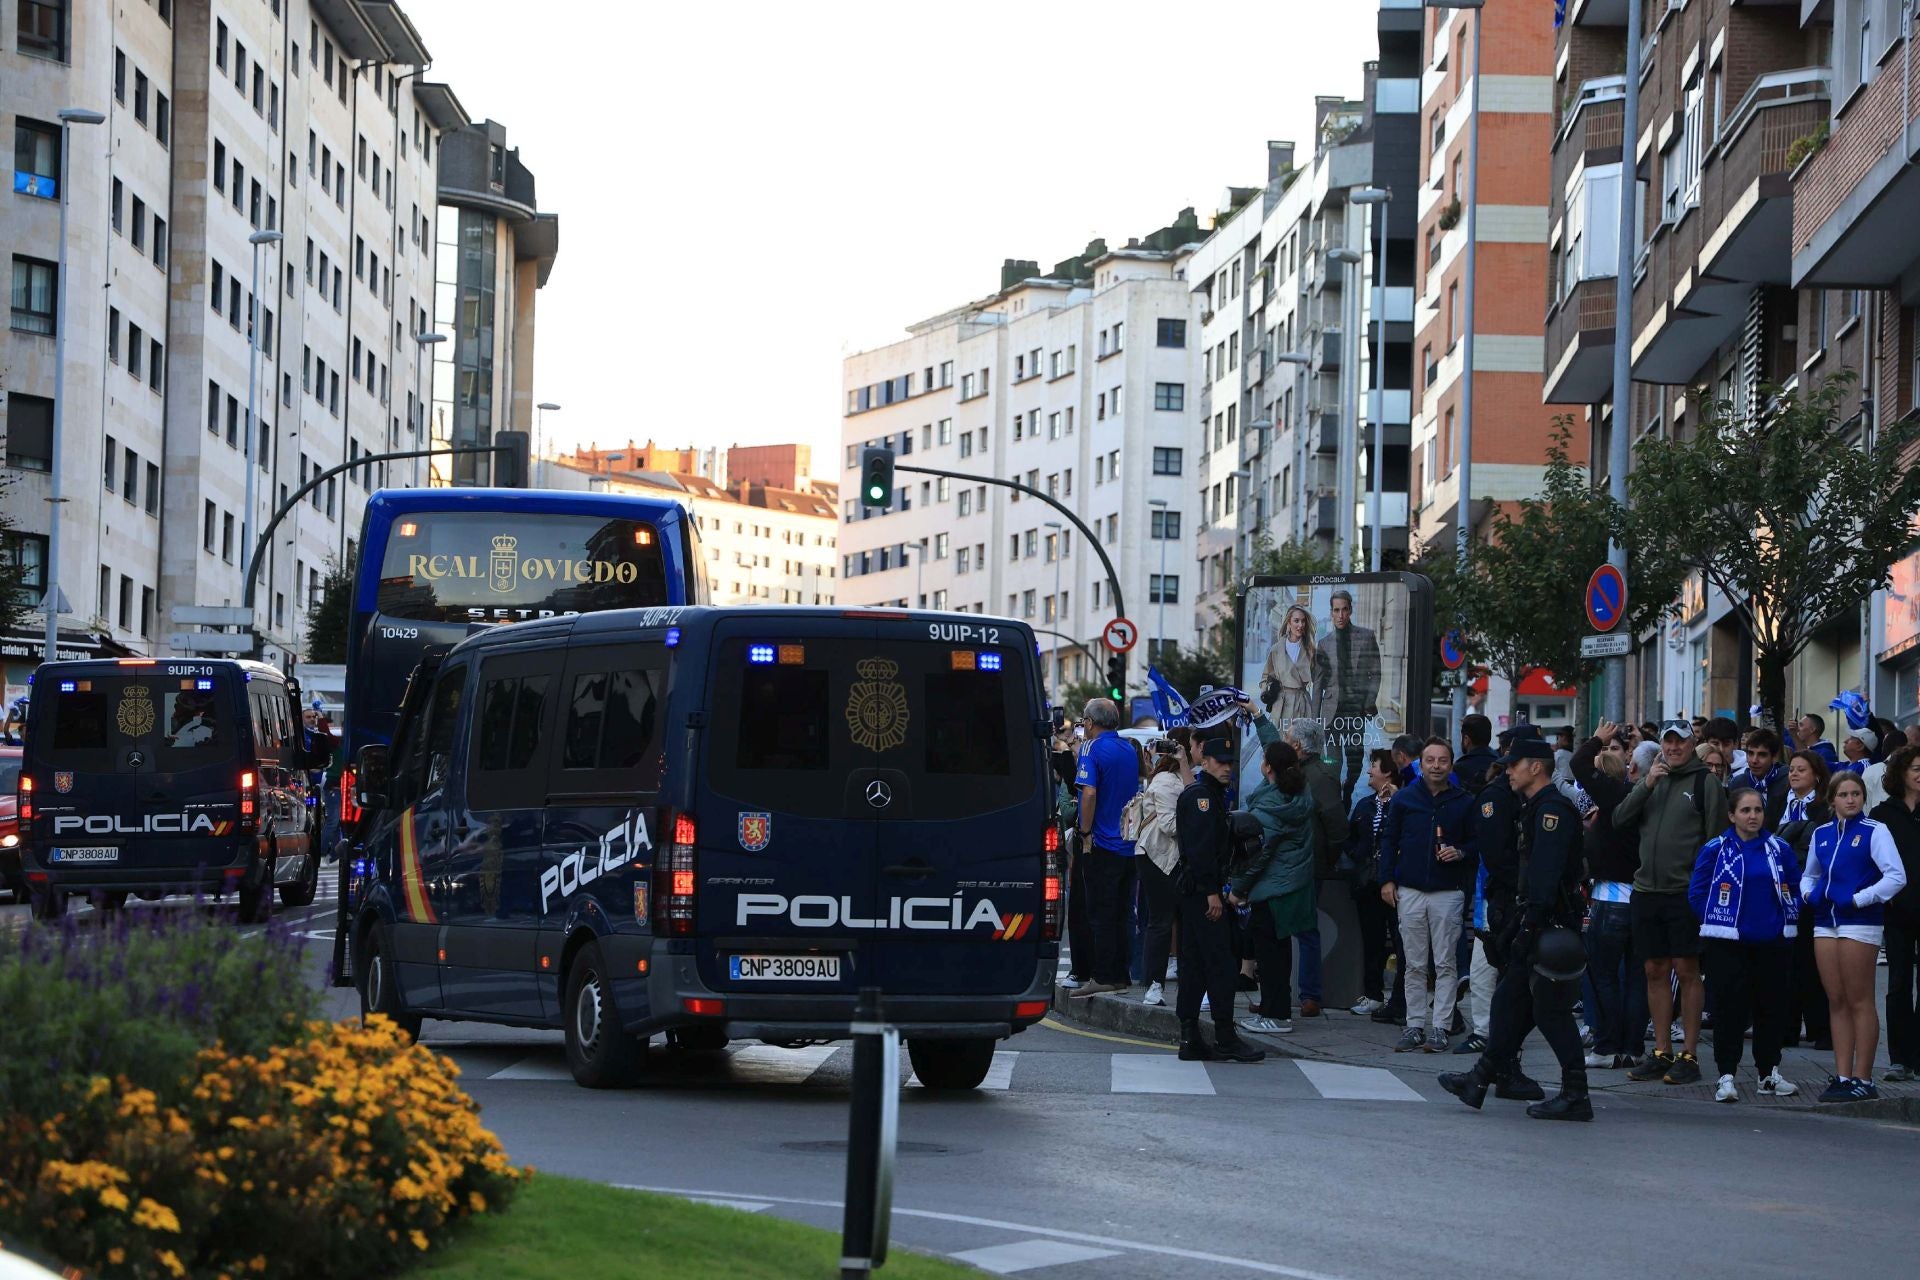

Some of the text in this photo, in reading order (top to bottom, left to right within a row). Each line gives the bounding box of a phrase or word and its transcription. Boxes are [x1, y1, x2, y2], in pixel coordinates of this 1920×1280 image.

[409, 554, 638, 584] REAL OVIEDO
[1310, 575, 1347, 584] JCDecaux
[381, 627, 418, 639] 10429
[928, 623, 1000, 644] 9UIP-12
[168, 666, 213, 676] 9UIP-10
[1333, 713, 1386, 731] OTOÑO
[1338, 732, 1381, 747] MODA
[54, 811, 215, 834] POLICÍA
[540, 810, 653, 914] POLICÍA
[707, 877, 775, 885] SPRINTER
[736, 890, 1005, 931] POLICÍA
